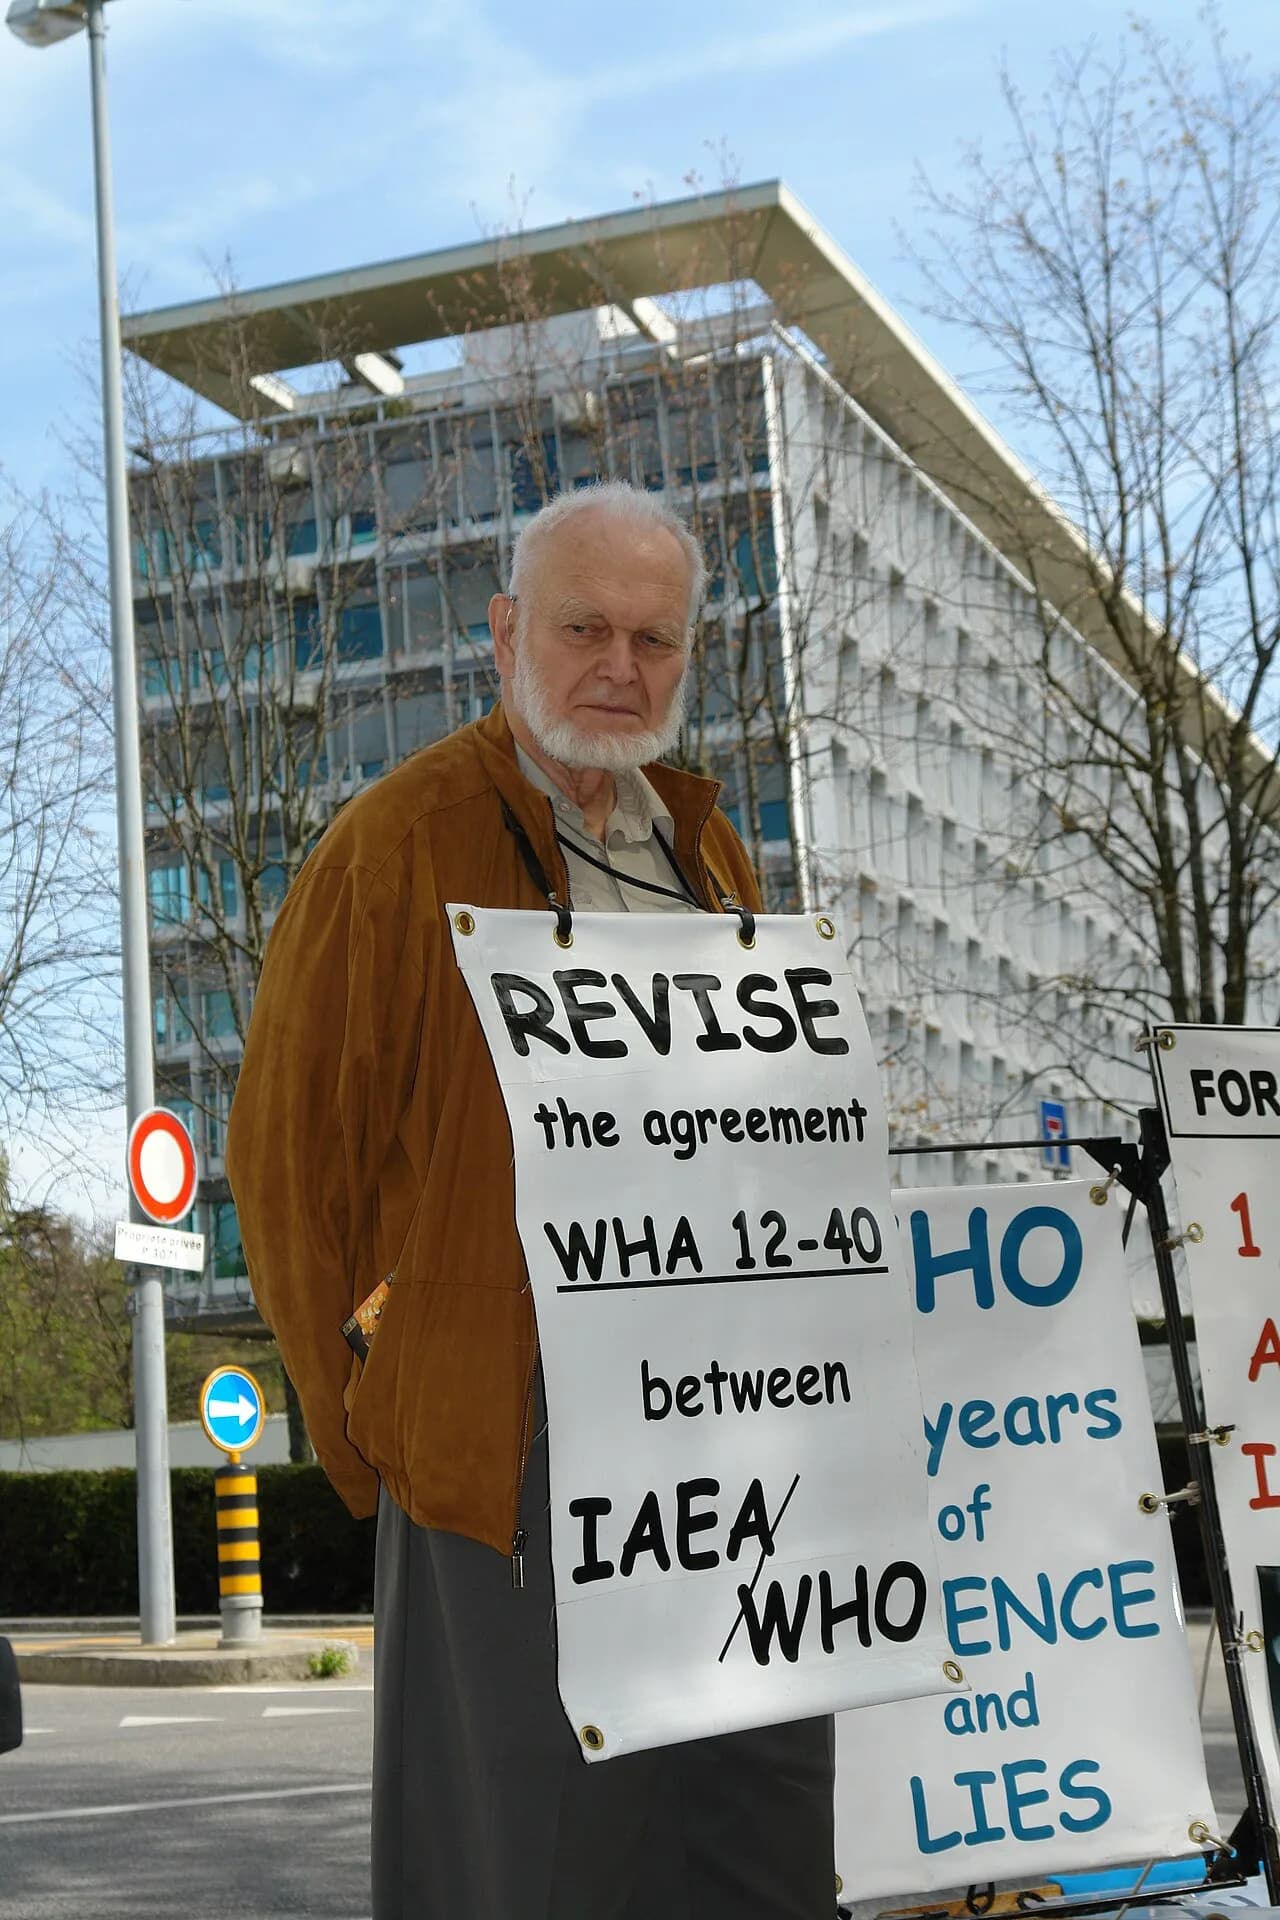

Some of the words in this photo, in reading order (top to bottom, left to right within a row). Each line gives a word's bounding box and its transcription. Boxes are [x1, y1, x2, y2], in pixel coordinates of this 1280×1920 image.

[490, 967, 850, 1059] REVISE
[533, 1096, 620, 1150] the
[642, 1097, 868, 1160] agreement
[1189, 1069, 1280, 1117] FOR
[543, 1215, 703, 1281] WHA
[731, 1206, 883, 1271] 12-40
[895, 1206, 1083, 1314] HO
[640, 1359, 851, 1421] between
[923, 1388, 1122, 1477] years
[937, 1484, 992, 1542] of
[942, 1560, 1160, 1657] ENCE
[943, 1671, 1040, 1735] and
[910, 1759, 1112, 1854] LIES
